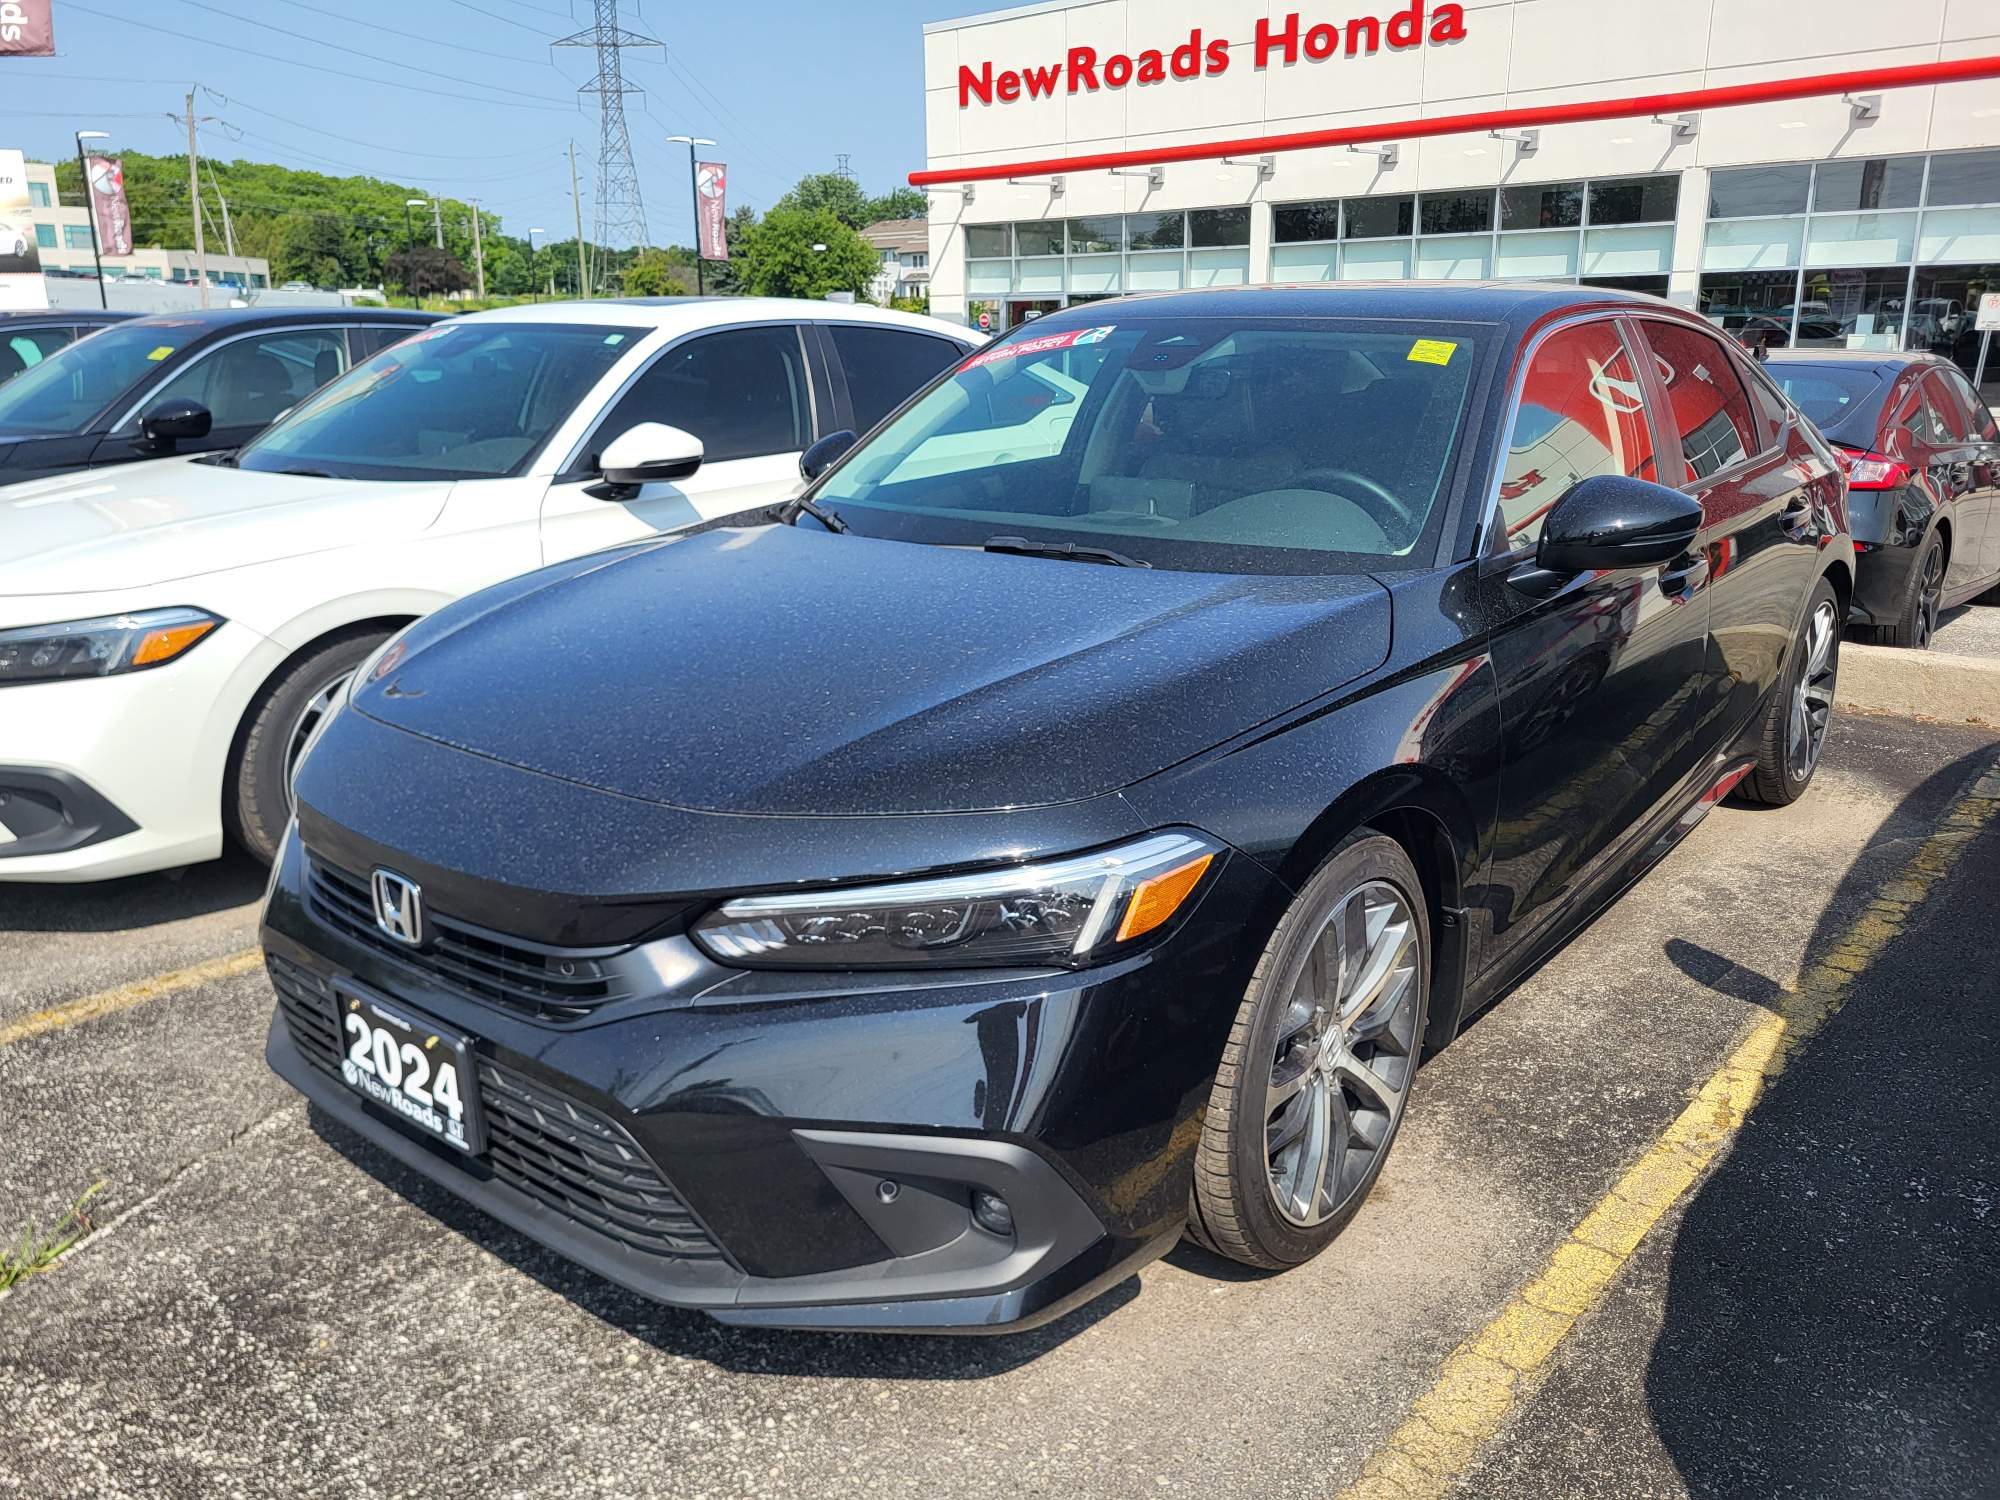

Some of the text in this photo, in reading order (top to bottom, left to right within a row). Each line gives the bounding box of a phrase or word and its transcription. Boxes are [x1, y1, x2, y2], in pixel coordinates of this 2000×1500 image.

[0, 0, 29, 42] ds
[958, 0, 1468, 108] NewRoads Honda
[345, 1012, 464, 1122] 2024
[358, 1068, 443, 1133] NewRoads
